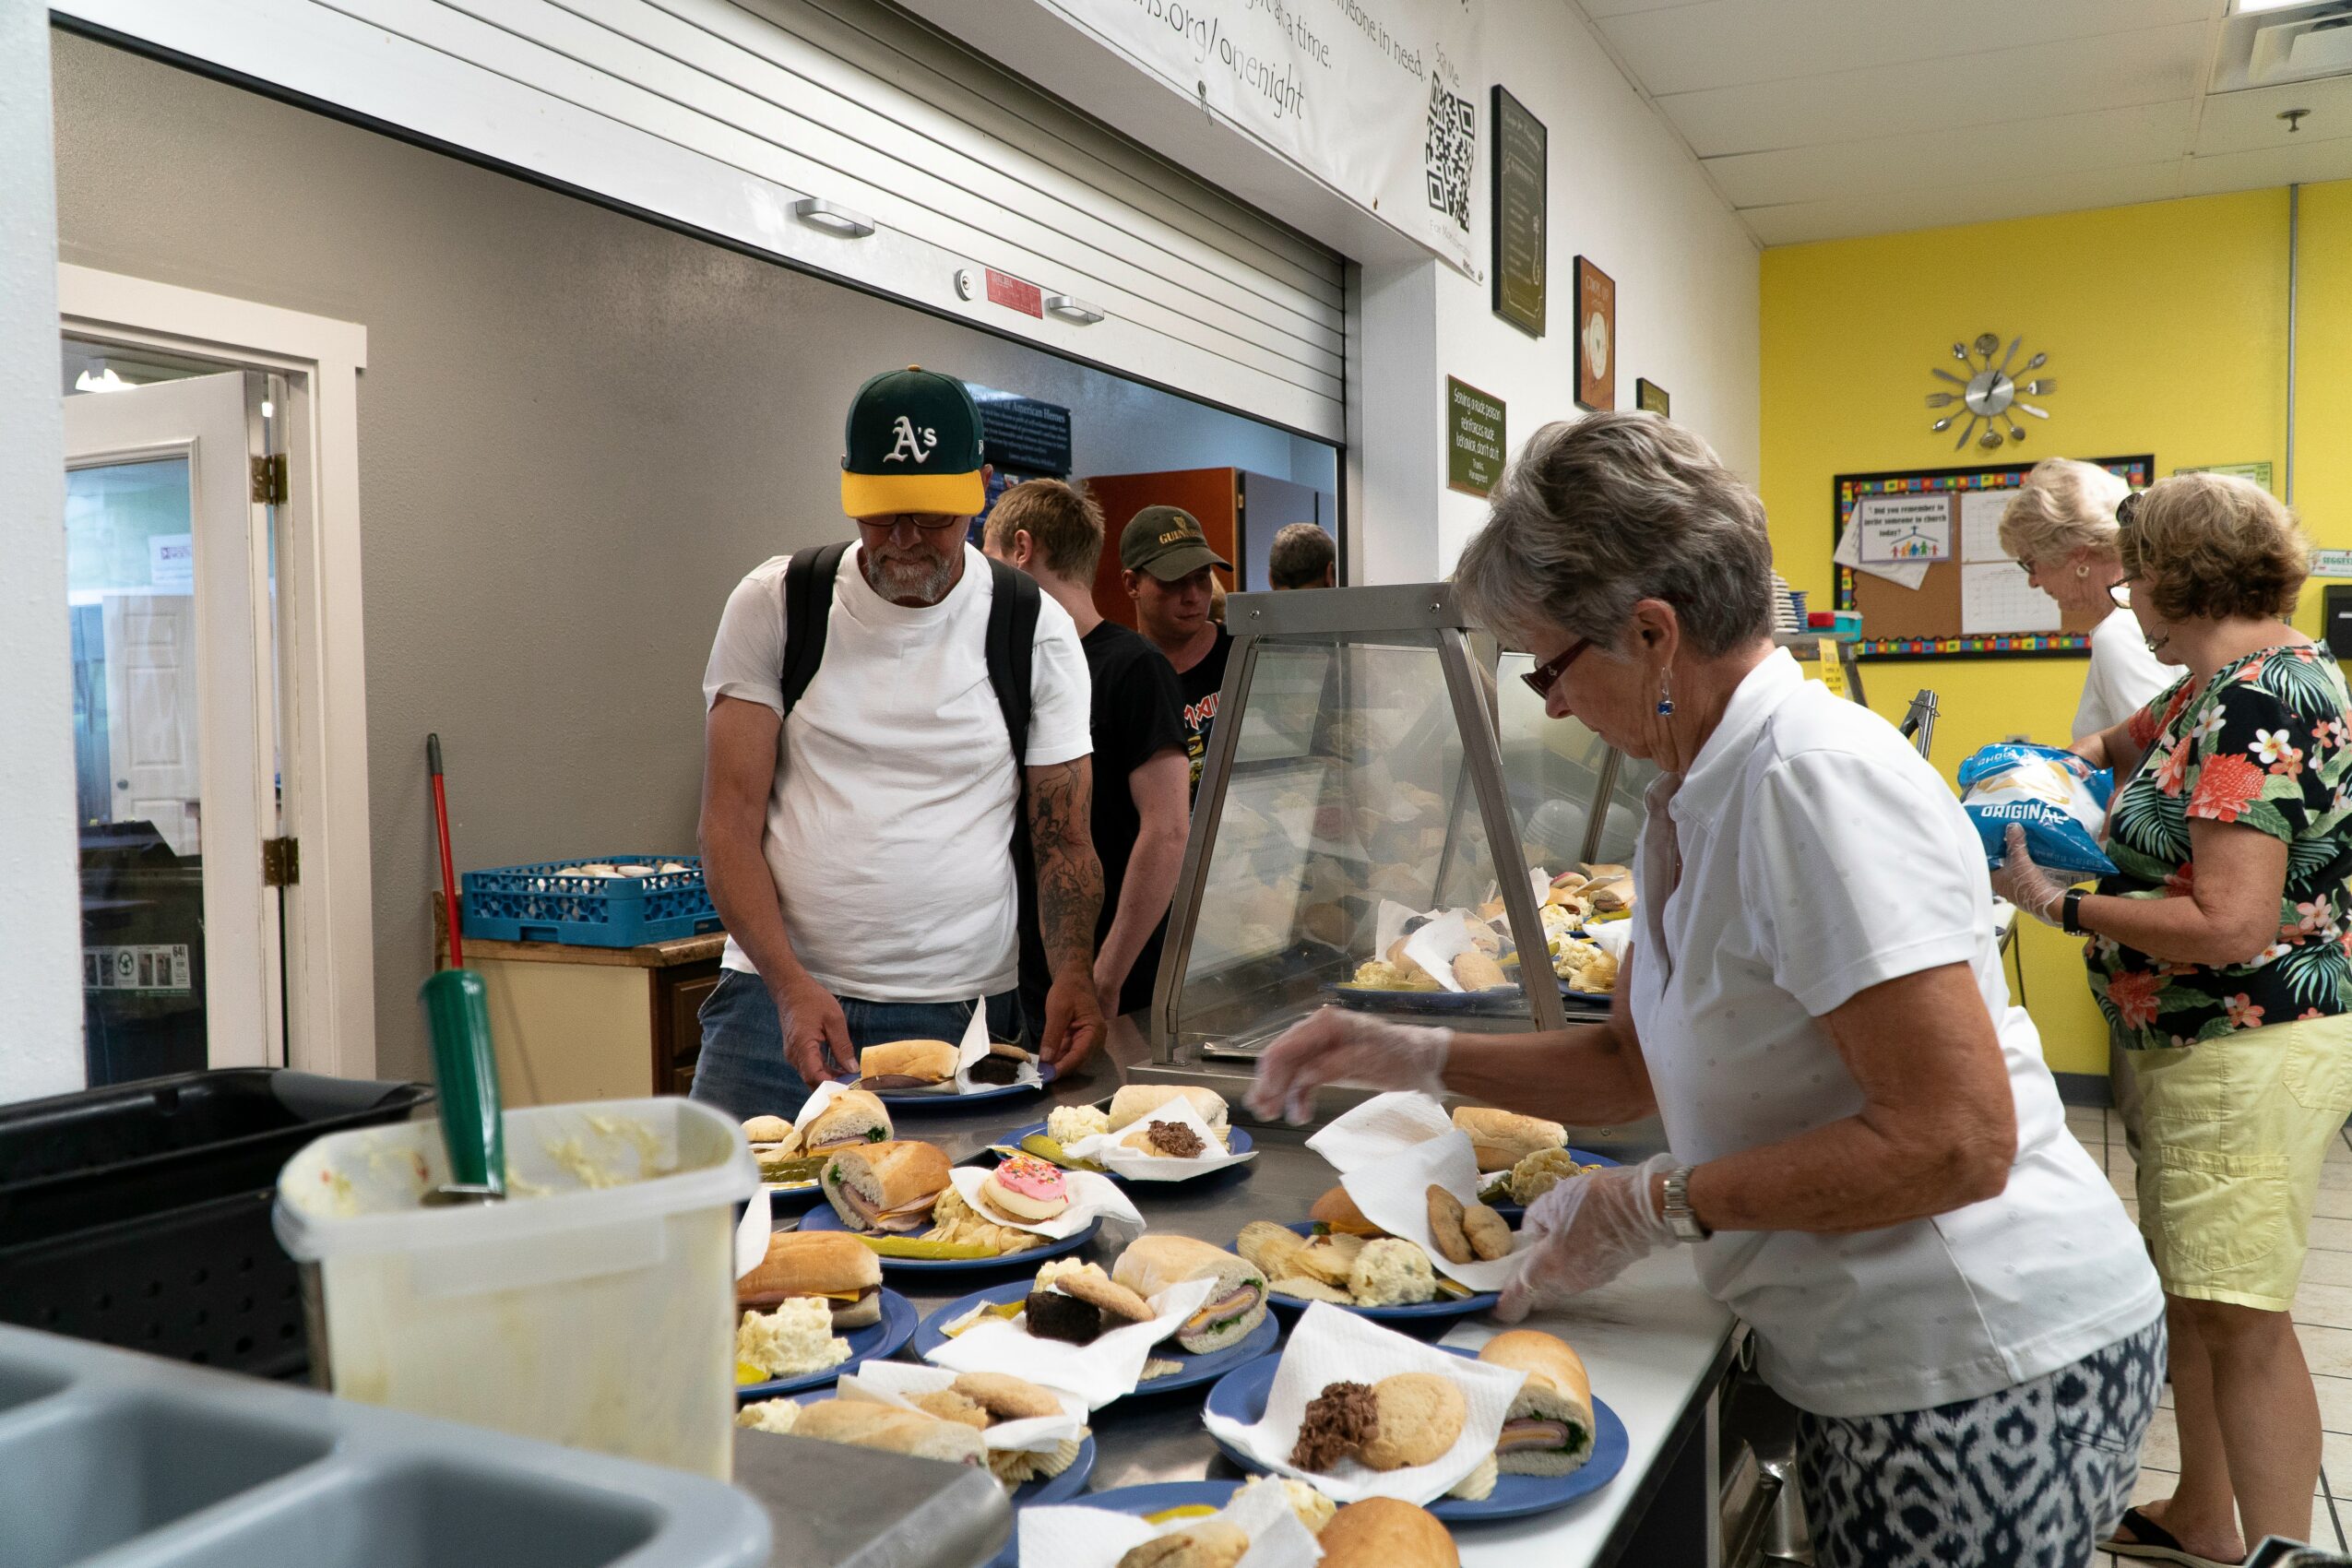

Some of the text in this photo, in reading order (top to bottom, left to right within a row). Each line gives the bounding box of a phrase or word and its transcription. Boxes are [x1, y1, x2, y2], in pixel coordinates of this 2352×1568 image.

[1296, 15, 1332, 69] time.
[1378, 22, 1390, 55] in
[1394, 41, 1427, 82] need.
[1454, 387, 1471, 415] Serving
[1485, 403, 1502, 422] person
[883, 415, 937, 464] A's
[1461, 416, 1484, 438] reinforces
[1884, 517, 1913, 525] someone
[1924, 515, 1947, 524] church
[1887, 505, 1899, 515] you
[1901, 505, 1935, 514] remember
